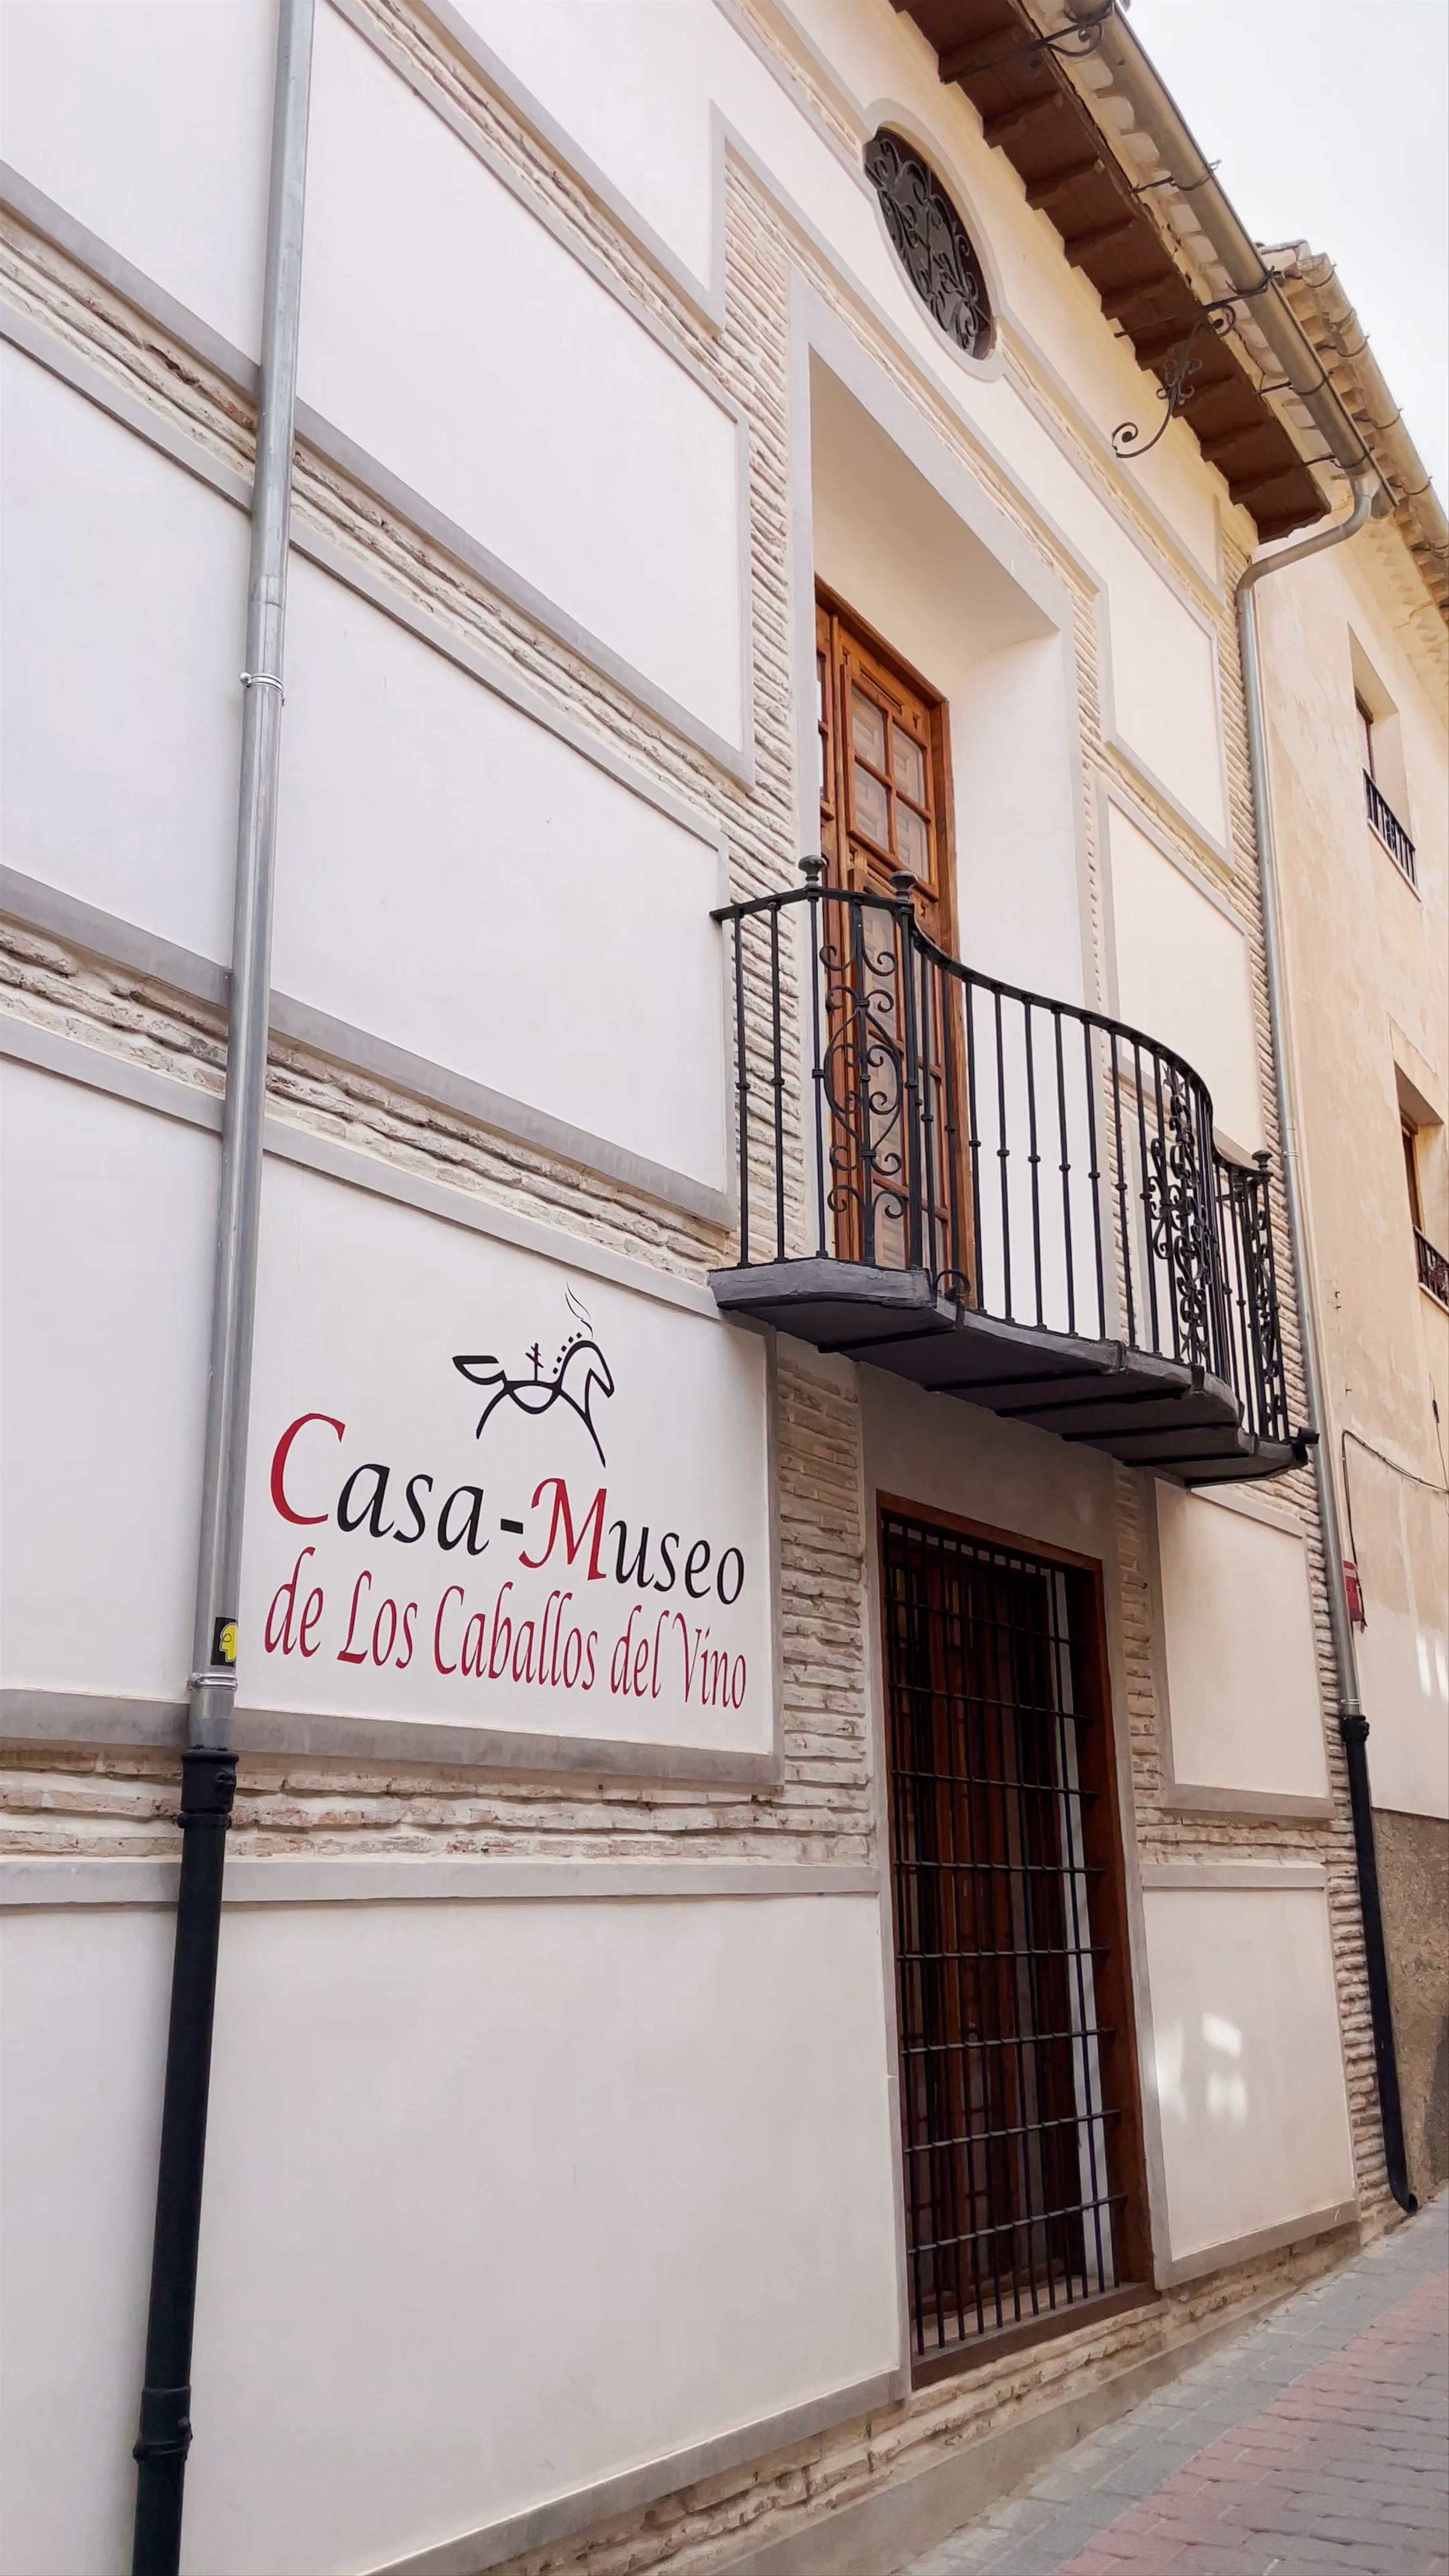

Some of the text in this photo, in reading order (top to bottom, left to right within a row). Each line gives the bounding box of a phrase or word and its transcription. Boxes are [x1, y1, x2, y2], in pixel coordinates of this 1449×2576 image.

[270, 1413, 745, 1605] Casa-Museo
[264, 1547, 324, 1658] de
[336, 1570, 418, 1669] Los
[434, 1581, 598, 1691] Caballos
[610, 1604, 670, 1699] del
